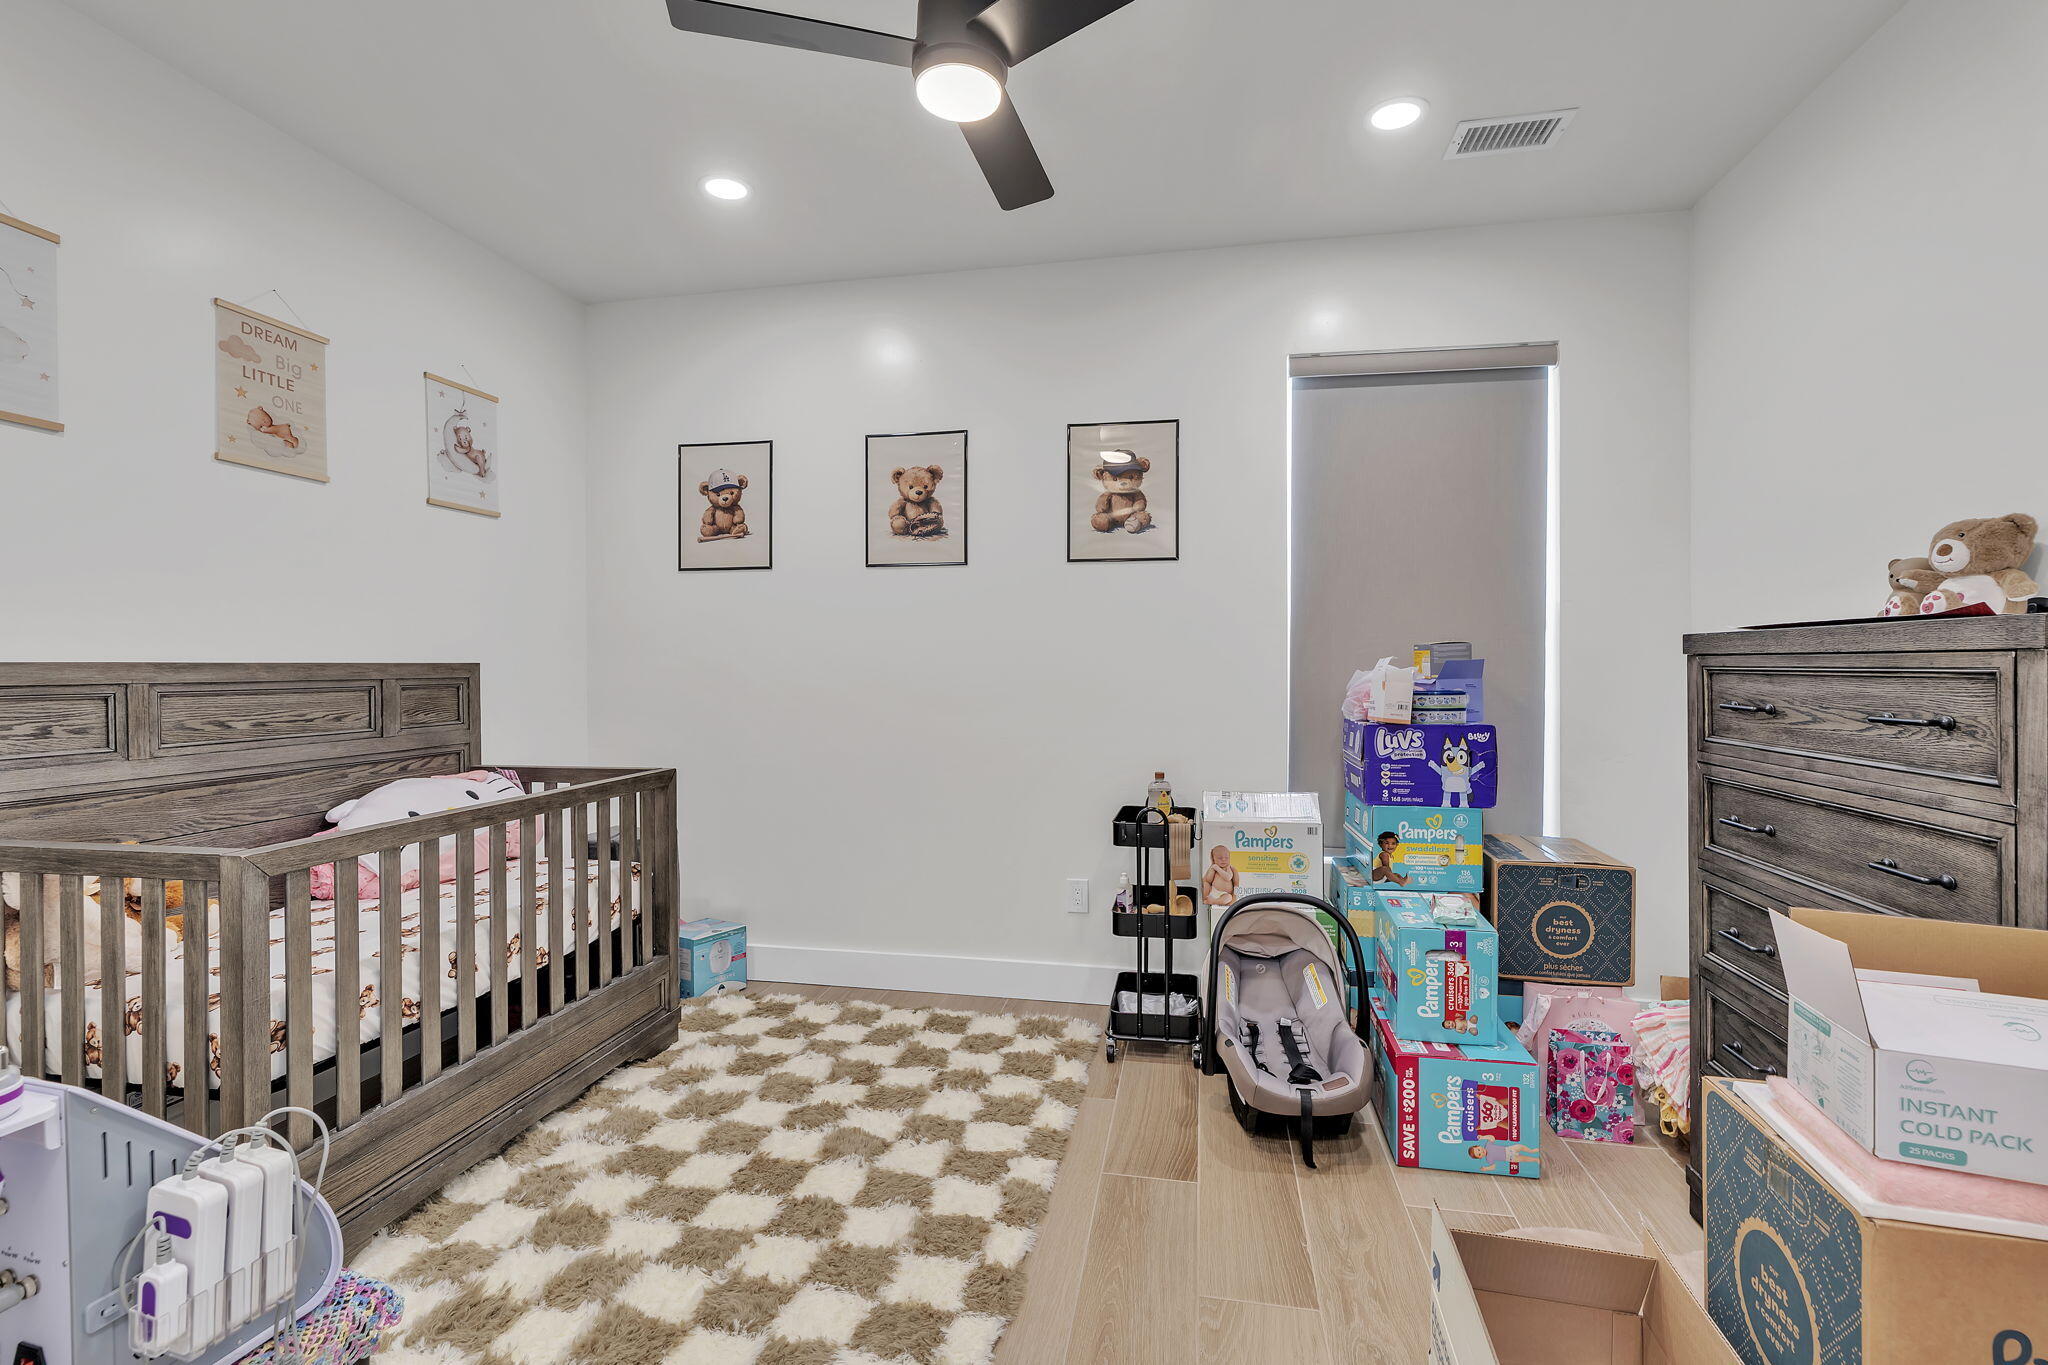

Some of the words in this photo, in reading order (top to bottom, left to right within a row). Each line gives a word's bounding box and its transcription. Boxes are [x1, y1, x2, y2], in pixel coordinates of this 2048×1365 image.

[241, 321, 298, 352] DREAM
[242, 365, 295, 392] LITTLE
[275, 355, 302, 380] Big
[272, 396, 303, 415] ONE
[1382, 789, 1389, 797] 3
[1234, 830, 1293, 851] Pampers
[1398, 821, 1457, 842] Pampers
[1545, 926, 1581, 934] dryness
[1553, 918, 1573, 926] best
[1543, 962, 1558, 970] plus
[1417, 958, 1442, 1017] Pamper
[1446, 978, 1455, 1010] cruisers
[1482, 1072, 1494, 1080] 3
[1438, 1075, 1464, 1144] Pampers
[1465, 1088, 1474, 1132] cruisers
[1900, 1097, 1999, 1124] INSTANT
[1403, 1124, 1415, 1159] SAVE
[1900, 1120, 1962, 1141] COLD
[1969, 1129, 2034, 1153] PACK
[1909, 1146, 1921, 1155] 25
[1922, 1148, 1956, 1160] PACKS
[1761, 1264, 1789, 1308] best
[1751, 1275, 1800, 1340] dryness
[1761, 1307, 1795, 1354] comfort
[1765, 1327, 1784, 1354] ever
